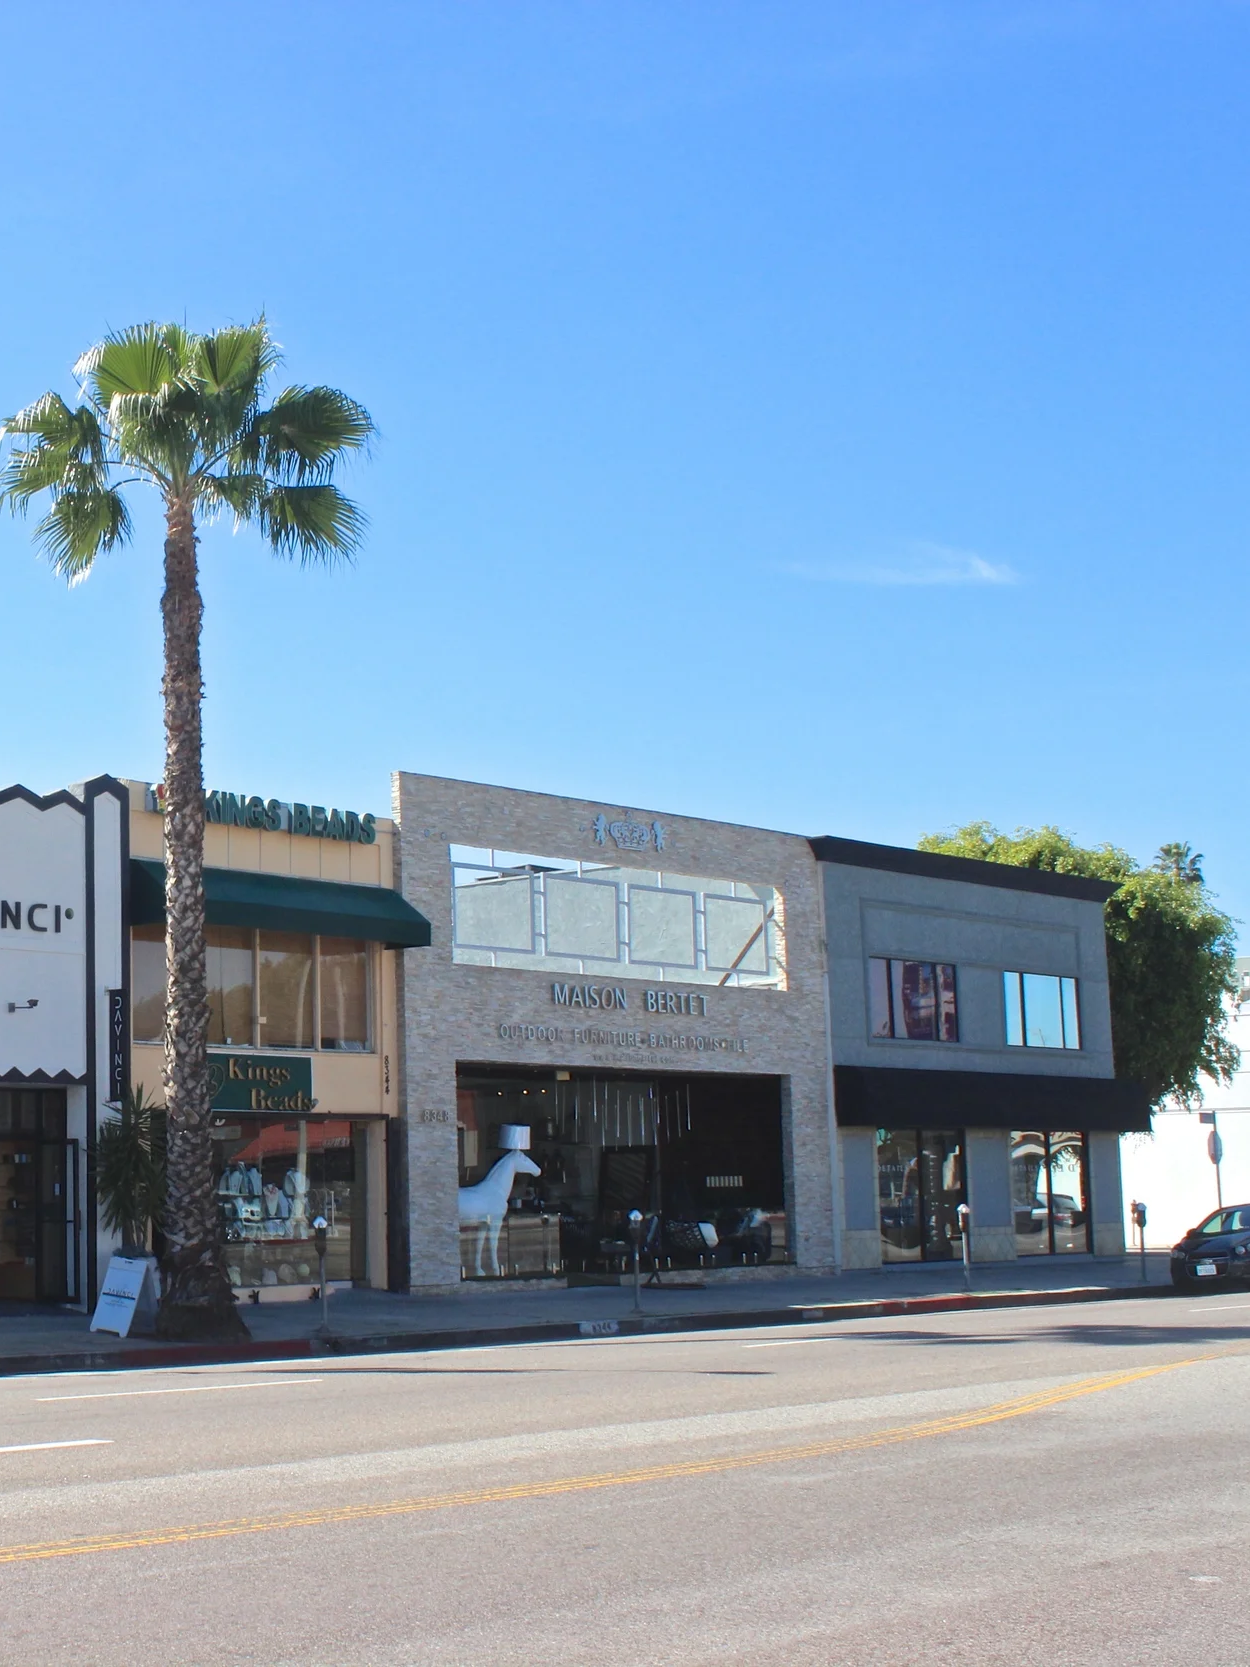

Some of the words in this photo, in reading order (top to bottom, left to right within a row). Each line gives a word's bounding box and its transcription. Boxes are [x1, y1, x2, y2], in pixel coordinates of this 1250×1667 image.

[200, 788, 282, 832] KINGS
[290, 802, 377, 845] BEADS
[552, 983, 628, 1010] MAISON
[646, 990, 710, 1016] BERTET
[114, 996, 123, 1095] DAVINCI
[500, 1023, 564, 1042] OUTDOOR
[574, 1029, 641, 1047] FURNITURE
[650, 1034, 720, 1051] BATHROOMS
[228, 1058, 291, 1088] Kings
[250, 1088, 312, 1112] Beads
[423, 1109, 449, 1122] 8348
